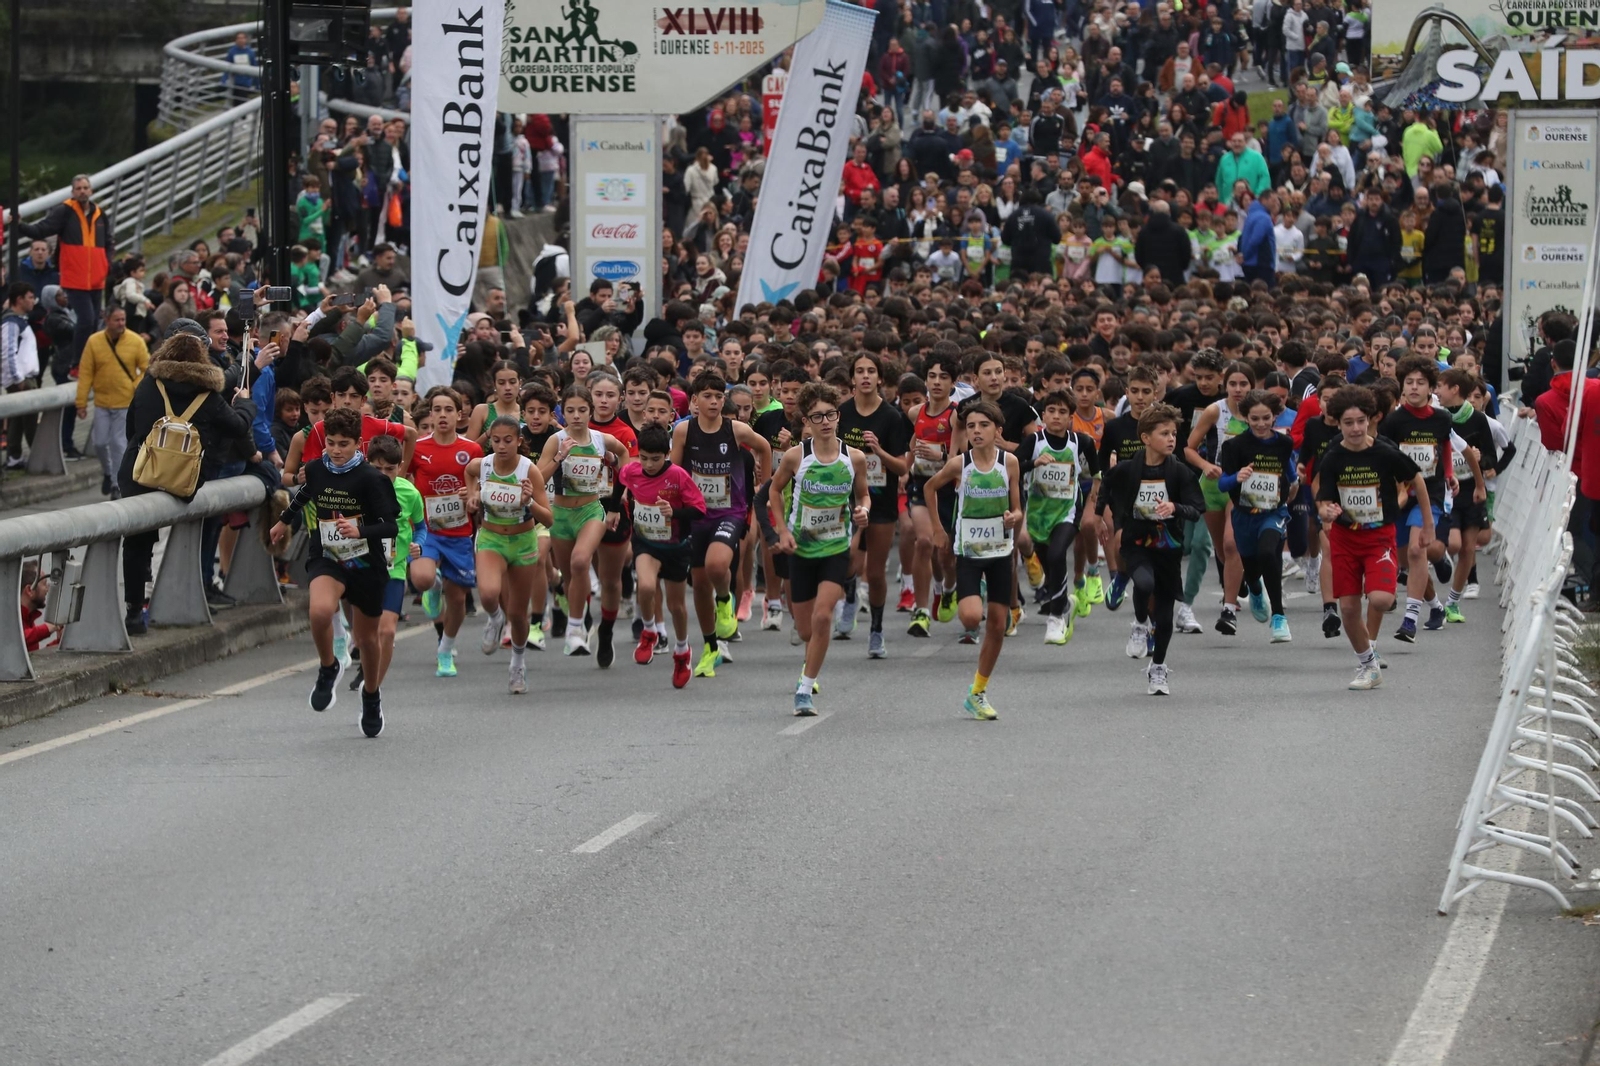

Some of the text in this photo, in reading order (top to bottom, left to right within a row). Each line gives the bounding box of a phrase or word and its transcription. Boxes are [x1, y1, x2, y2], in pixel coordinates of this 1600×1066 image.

[662, 7, 759, 35] XLVIII
[509, 26, 564, 43] SAN
[660, 39, 765, 54] OURENSE 9-11-2025
[509, 64, 635, 73] CARREIRA PEDESTRE POPULAR
[510, 75, 636, 92] OURENSE
[1545, 133, 1588, 141] OURENSE
[437, 5, 484, 296] CaixaBank
[600, 140, 645, 150] CaixaBank
[771, 59, 847, 270] CaixaBank
[1541, 160, 1584, 170] CaixaBank
[1531, 196, 1555, 204] SAN
[1530, 217, 1587, 226] OURENSE
[1538, 280, 1580, 290] CaixaBank
[572, 464, 597, 475] 6219
[1042, 470, 1066, 481] 6502
[1250, 480, 1275, 492] 6638
[317, 494, 328, 502] SAN
[490, 491, 516, 503] 6609
[1140, 491, 1165, 502] 5739
[1347, 494, 1372, 505] 6080
[435, 501, 460, 514] 6108
[637, 511, 660, 523] 6619
[810, 513, 835, 526] 5934
[969, 526, 995, 538] 9761
